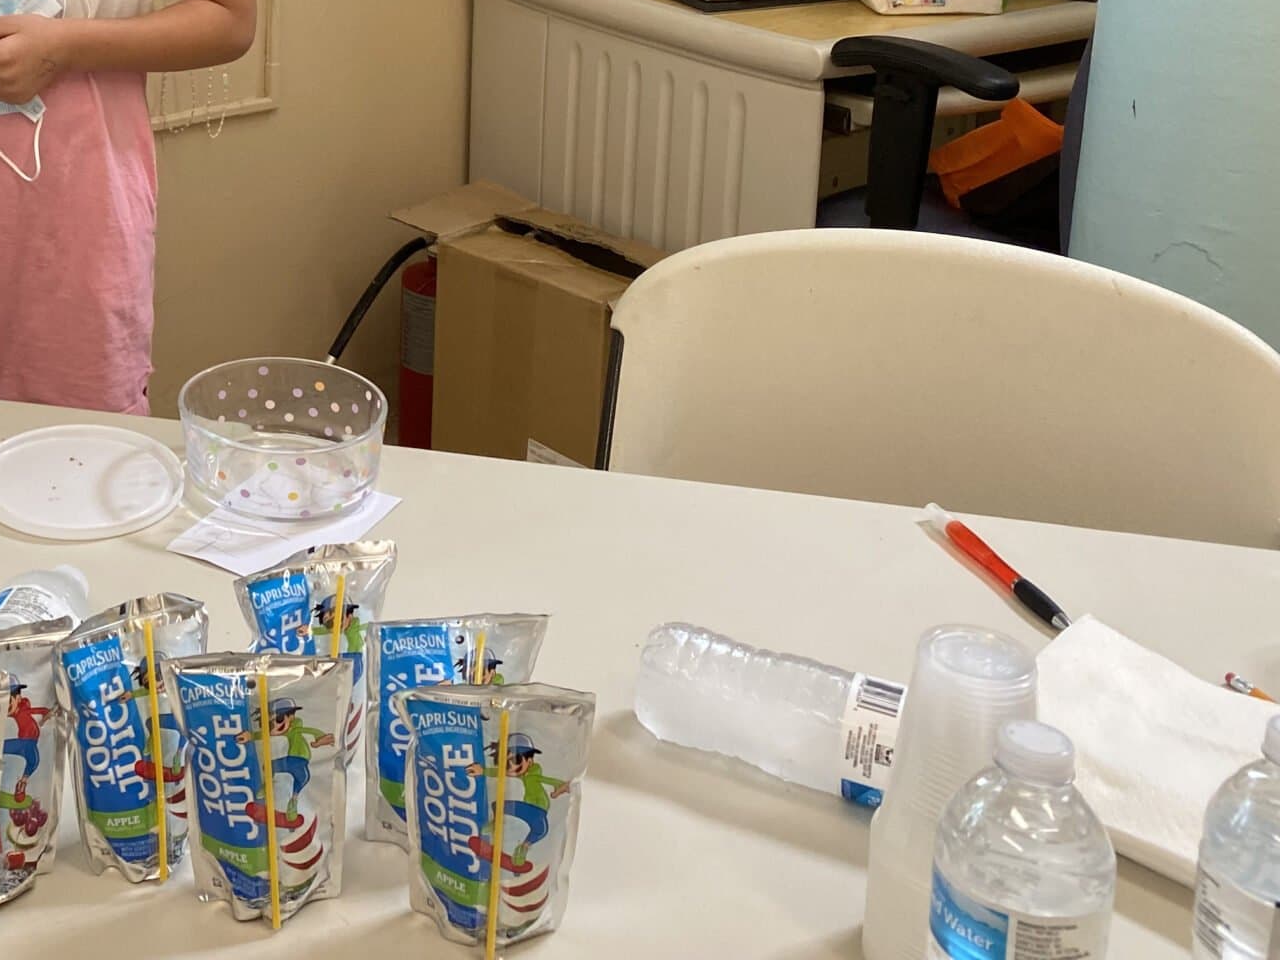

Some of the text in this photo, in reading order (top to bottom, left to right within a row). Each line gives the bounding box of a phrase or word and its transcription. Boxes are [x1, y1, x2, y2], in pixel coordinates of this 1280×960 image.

[83, 699, 112, 789] 100%
[99, 676, 151, 802] JUICE
[190, 725, 225, 816] 100%
[212, 714, 260, 840] JUICE
[106, 815, 141, 827] APPLE
[419, 754, 448, 838] 100%
[442, 743, 481, 874] JUICE
[219, 846, 248, 864] APPLE
[436, 871, 466, 892] APPLE
[943, 912, 994, 950] Water
